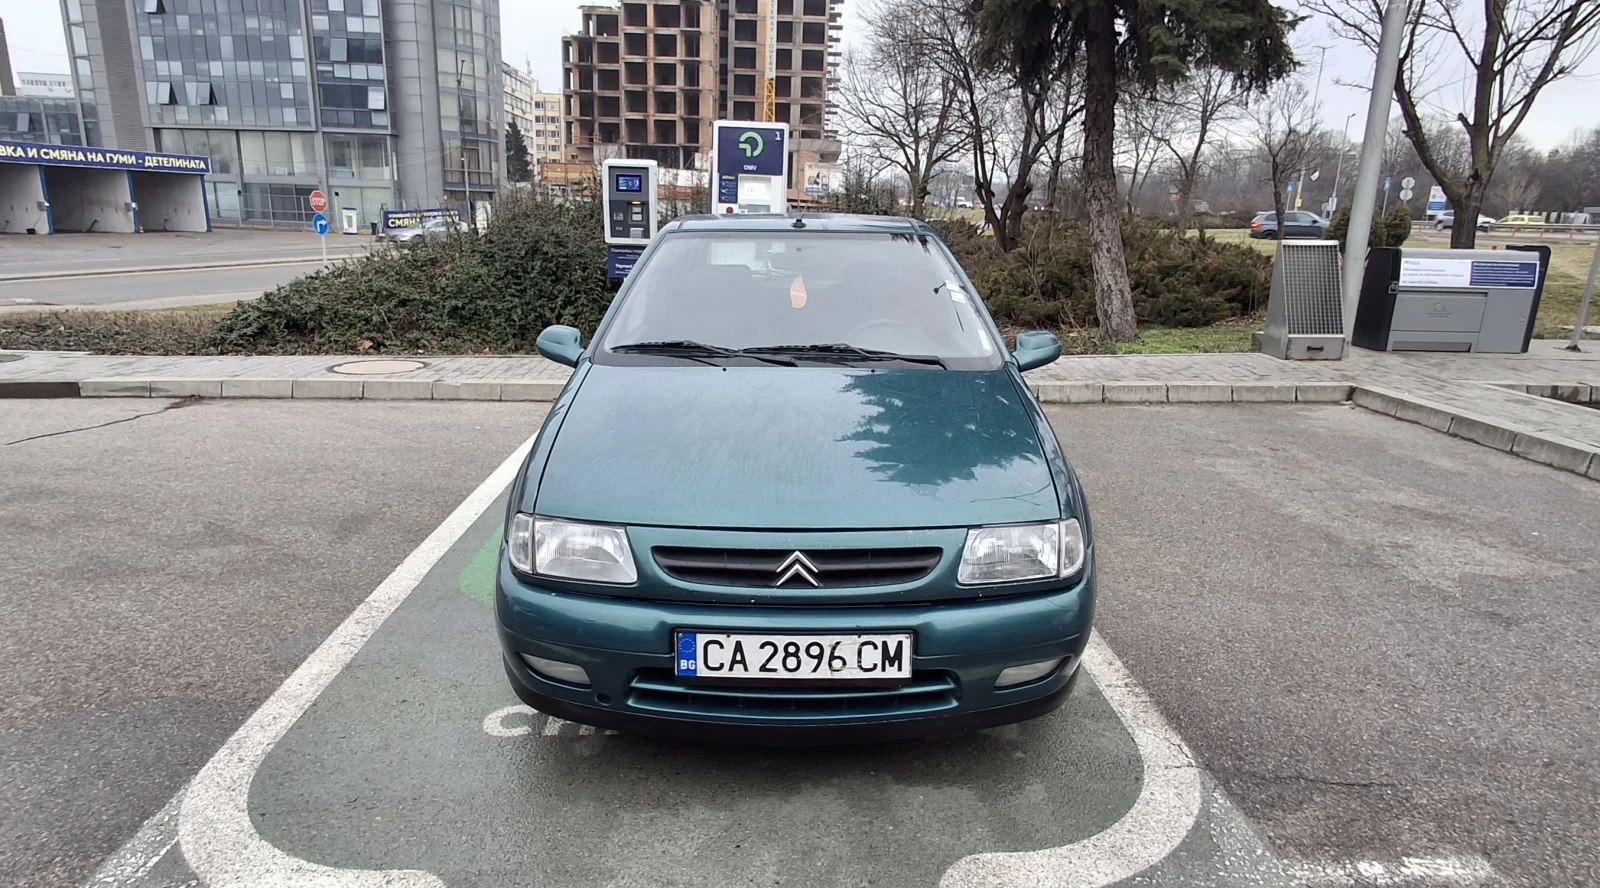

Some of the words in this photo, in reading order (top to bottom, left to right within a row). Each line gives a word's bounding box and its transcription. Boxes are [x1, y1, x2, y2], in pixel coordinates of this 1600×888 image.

[775, 131, 781, 140] 1
[27, 147, 37, 158] И
[40, 148, 85, 162] СМЯНА
[88, 152, 104, 163] НА
[106, 153, 136, 165] ГУМИ
[145, 156, 206, 170] ДЕТЕЛИНАТА
[311, 197, 326, 206] STOP
[702, 639, 749, 672] CA
[758, 640, 847, 673] 2896
[857, 640, 903, 673] CM
[680, 659, 696, 670] BG
